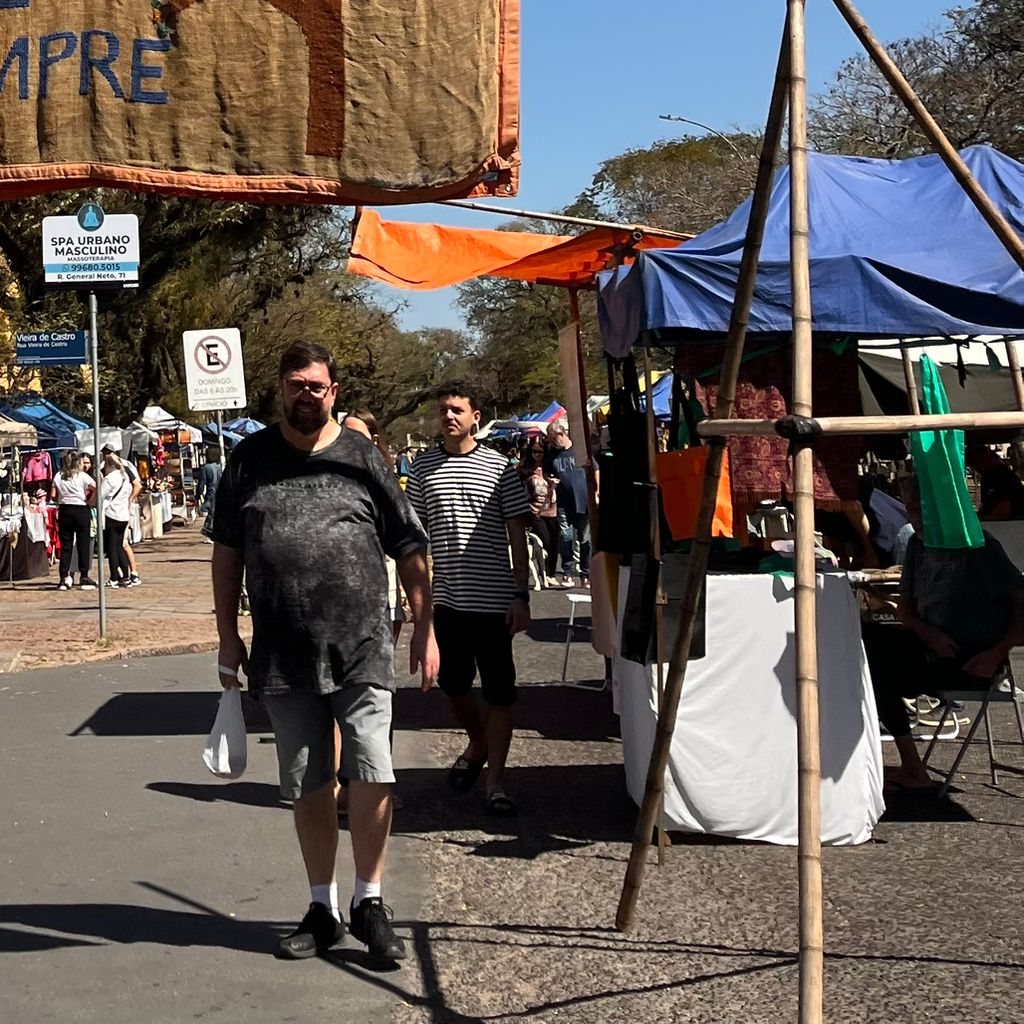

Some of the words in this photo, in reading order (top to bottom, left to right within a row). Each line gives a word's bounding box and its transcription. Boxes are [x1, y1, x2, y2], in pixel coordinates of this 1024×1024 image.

[50, 236, 74, 246] SPA
[78, 235, 130, 246] URBANO
[55, 245, 127, 256] MASCULINO
[71, 263, 120, 272] 99680.5015
[16, 333, 37, 342] Vieira
[39, 332, 49, 341] de
[51, 332, 76, 341] Castro
[205, 343, 220, 366] E
[198, 377, 231, 386] DOMINGO
[194, 387, 208, 395] DAS
